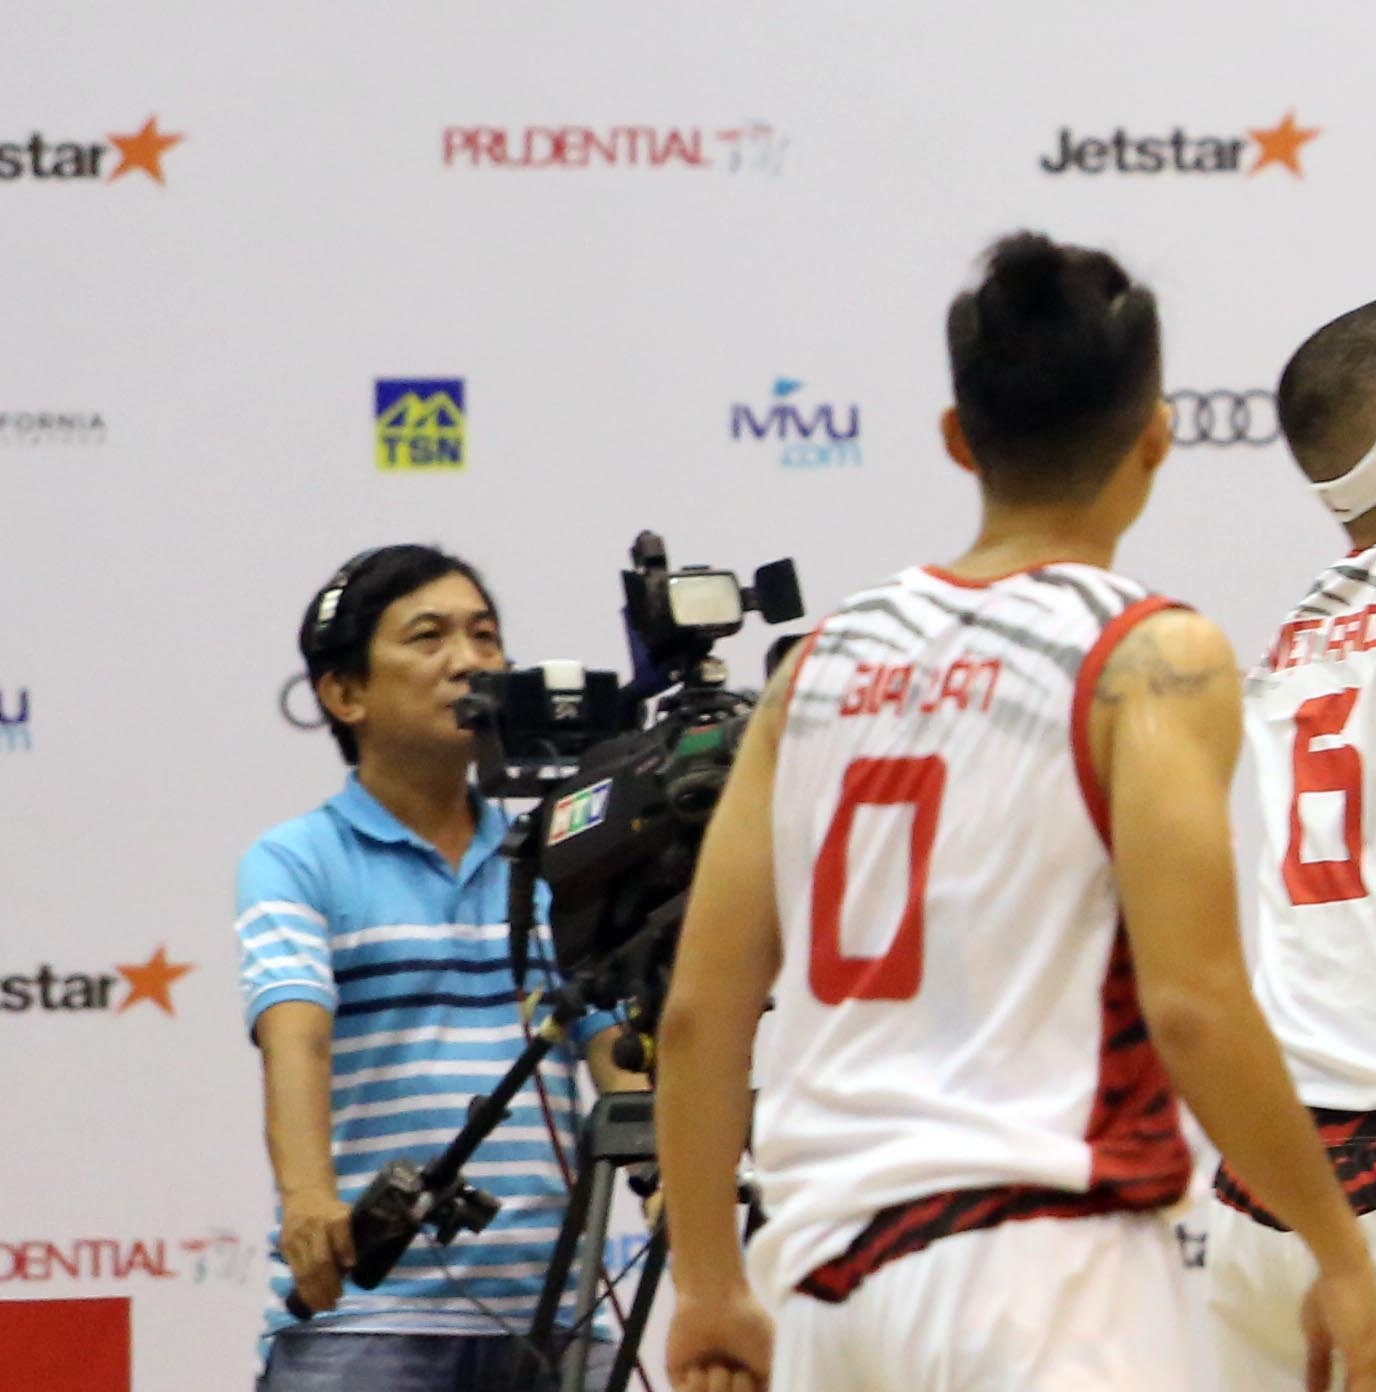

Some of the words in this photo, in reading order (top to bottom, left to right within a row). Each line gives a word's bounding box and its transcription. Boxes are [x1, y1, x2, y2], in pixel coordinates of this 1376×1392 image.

[443, 125, 712, 169] PRUDENTIAL
[1040, 126, 1244, 174] Jetstar
[384, 435, 461, 465] TSN
[1282, 687, 1369, 906] 6
[808, 754, 948, 1006] 0
